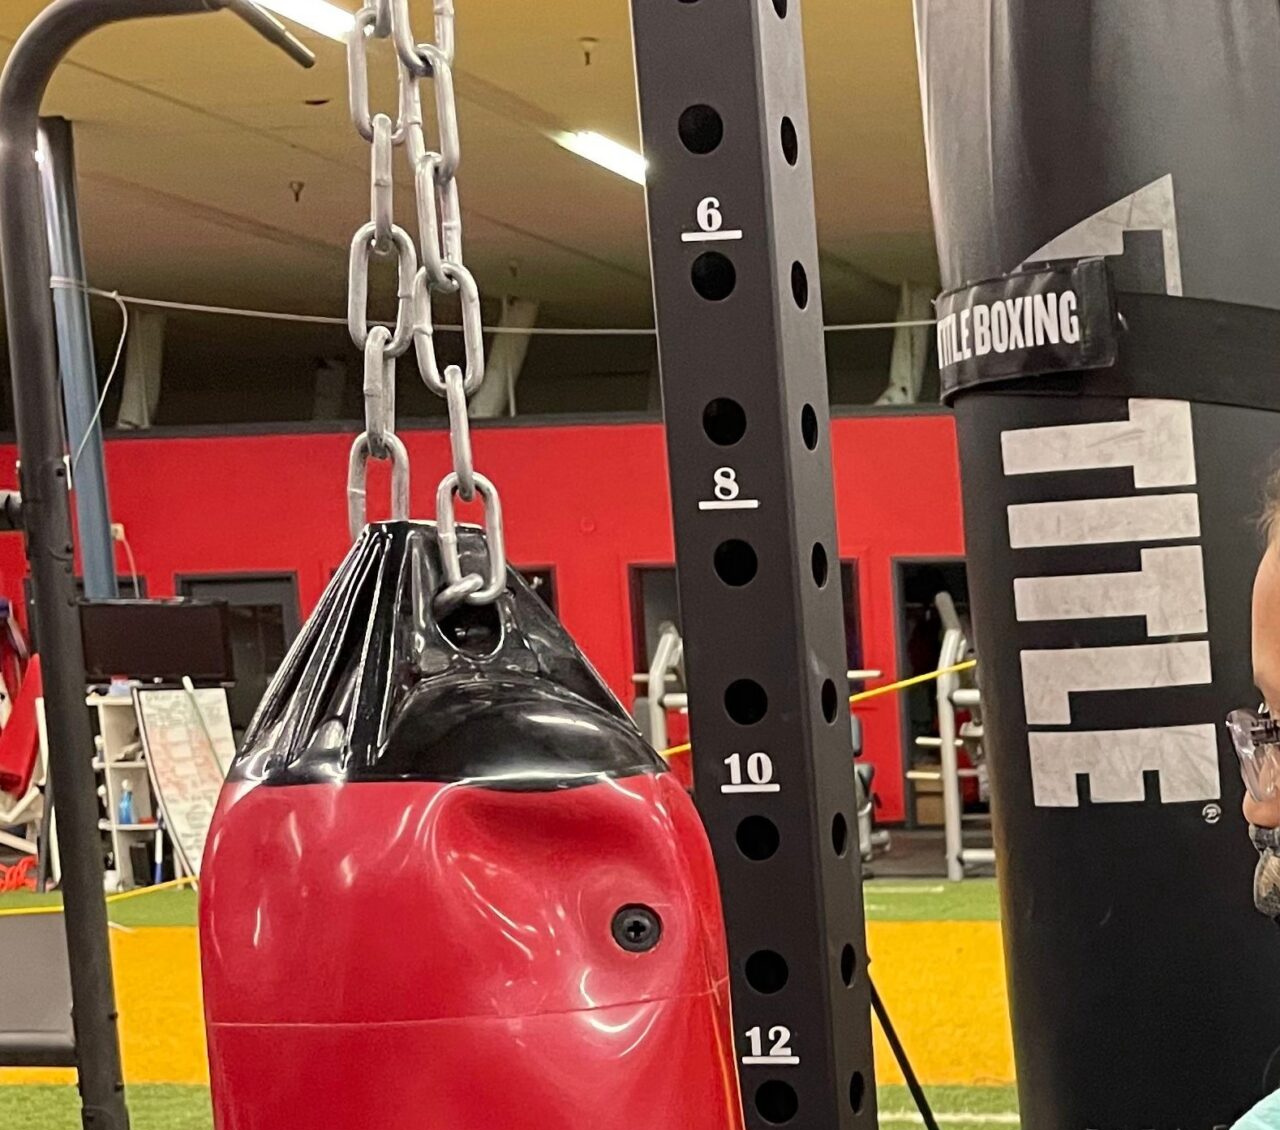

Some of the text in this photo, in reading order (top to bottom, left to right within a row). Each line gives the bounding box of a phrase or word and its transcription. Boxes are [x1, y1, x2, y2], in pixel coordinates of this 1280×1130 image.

[697, 197, 723, 232] 6
[974, 290, 1080, 356] BOXING
[713, 467, 740, 500] 8
[1001, 398, 1221, 807] TITLE
[724, 752, 773, 785] 10
[745, 1025, 792, 1057] 12
